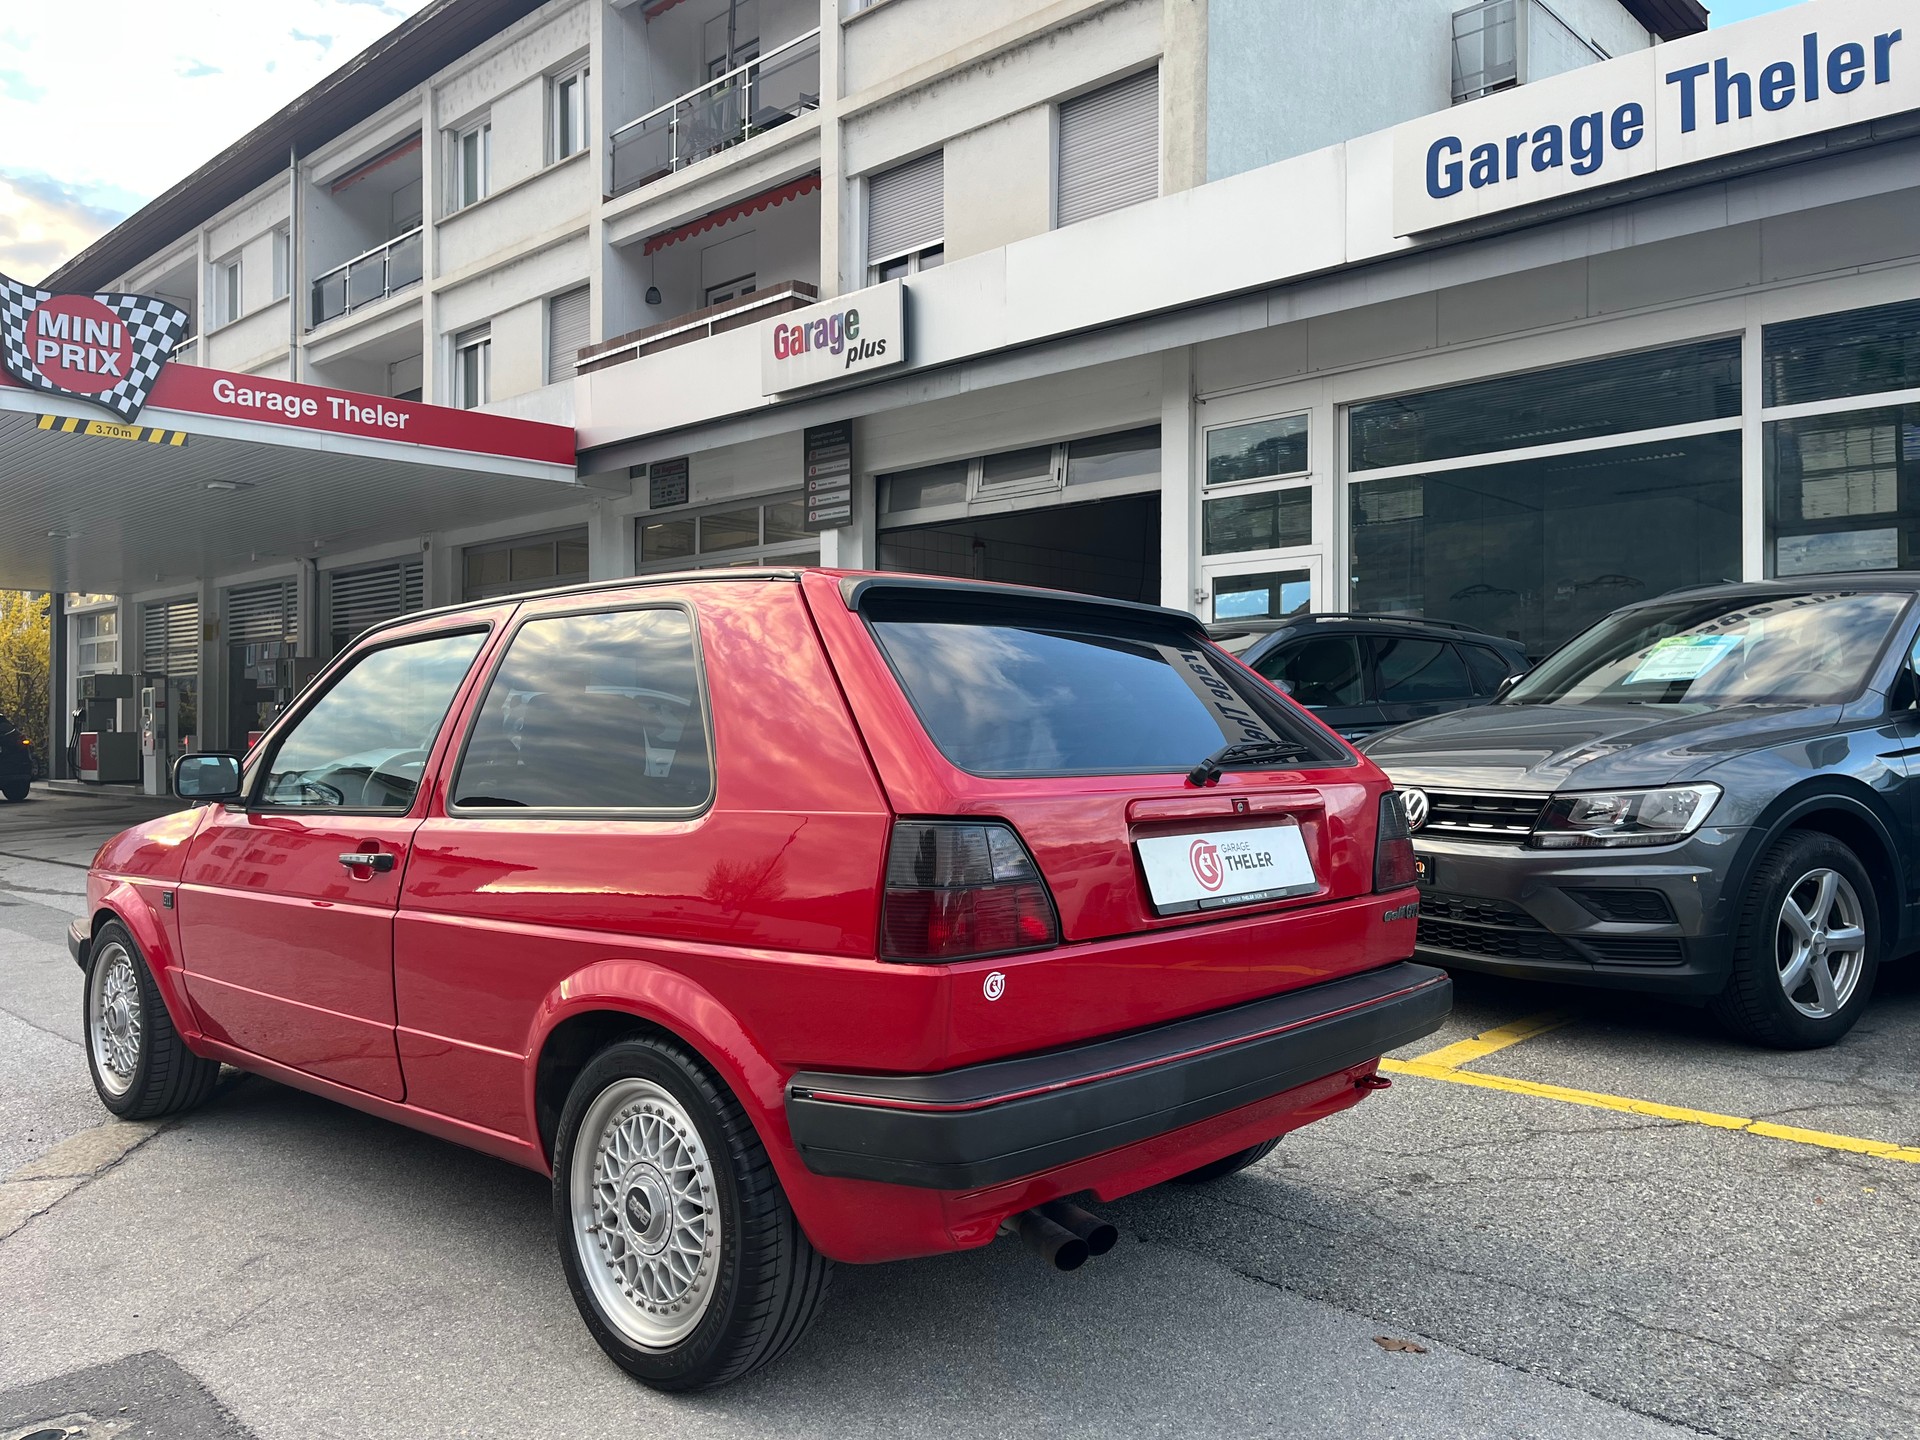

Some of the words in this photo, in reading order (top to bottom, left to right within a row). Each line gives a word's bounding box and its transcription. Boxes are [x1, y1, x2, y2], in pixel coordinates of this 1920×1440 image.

[1426, 102, 1644, 199] Garage
[1666, 28, 1903, 134] Theler
[37, 309, 122, 349] MINI
[774, 308, 859, 360] Garage
[37, 339, 122, 377] PRIX
[845, 338, 887, 369] plus
[213, 379, 318, 419] Garage
[326, 396, 410, 429] Theler
[1220, 841, 1251, 853] GARAGE
[1224, 851, 1274, 871] THELER
